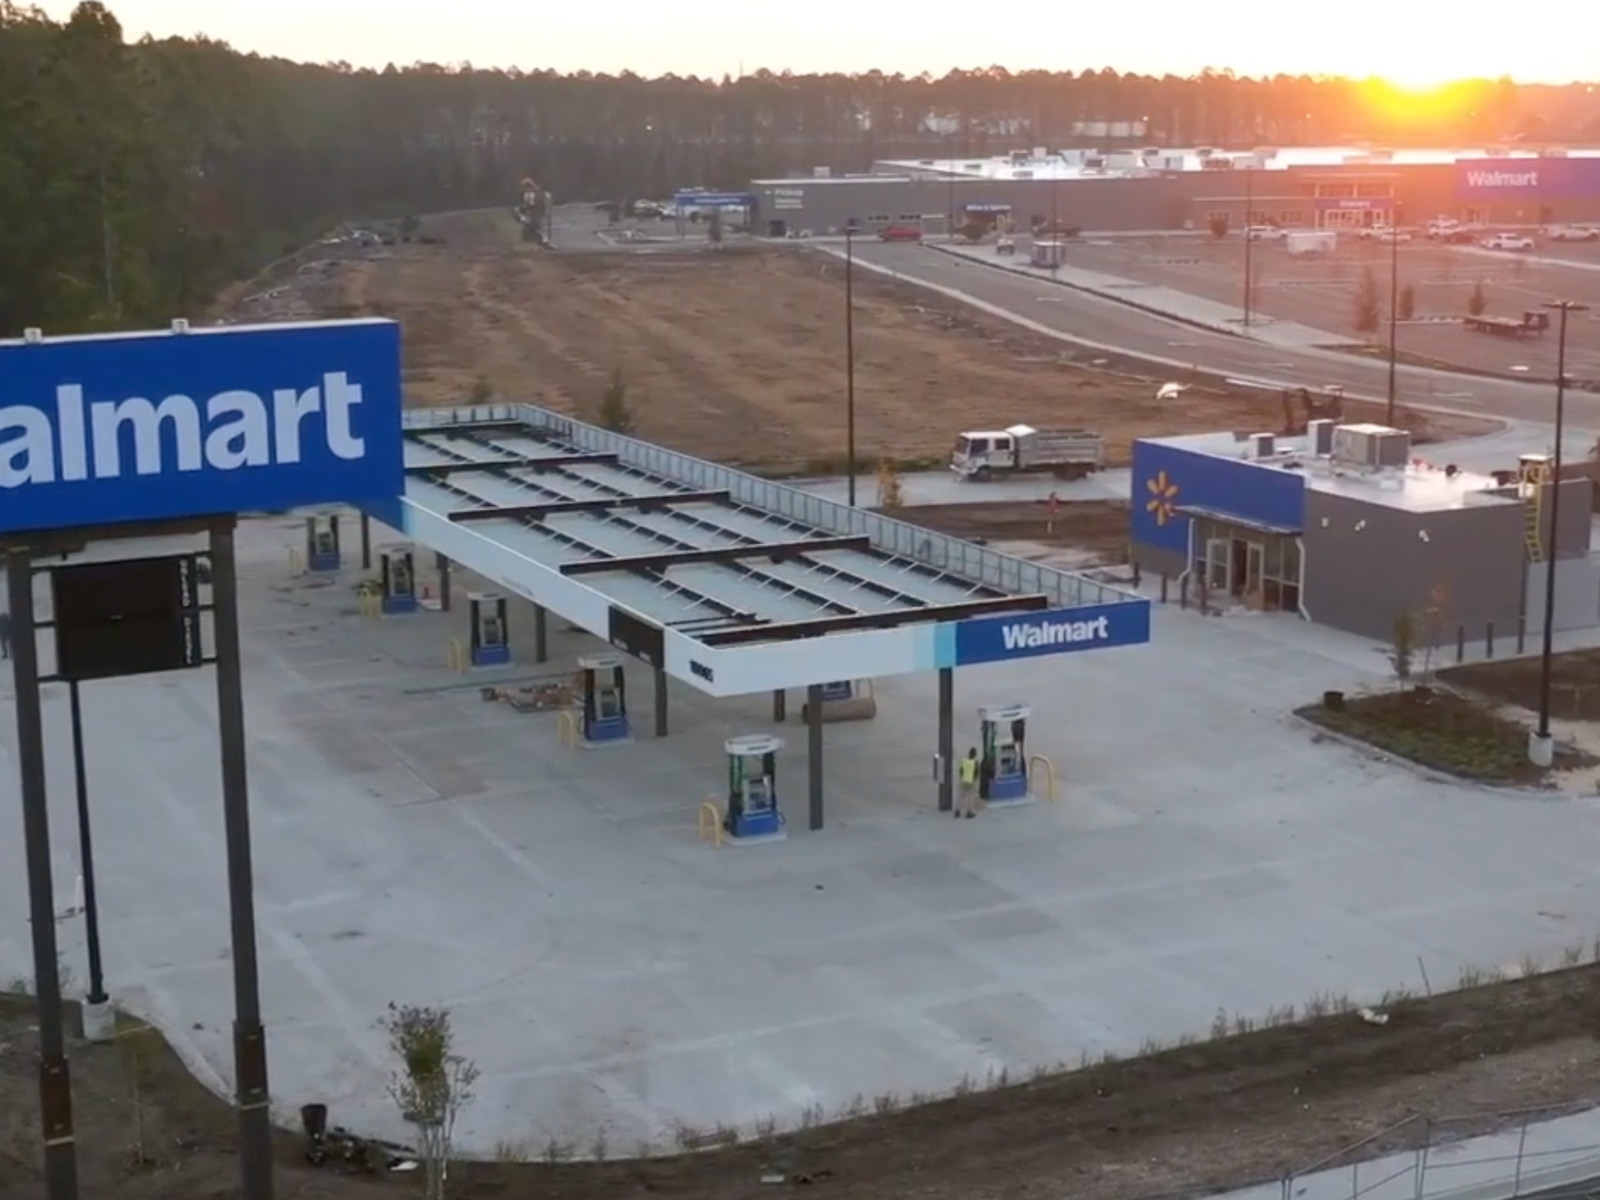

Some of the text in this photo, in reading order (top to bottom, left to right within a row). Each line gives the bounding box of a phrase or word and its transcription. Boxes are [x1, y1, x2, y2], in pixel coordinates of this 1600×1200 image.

[1466, 171, 1538, 187] Walmart
[0, 371, 366, 488] almart
[1002, 615, 1109, 650] Walmart
